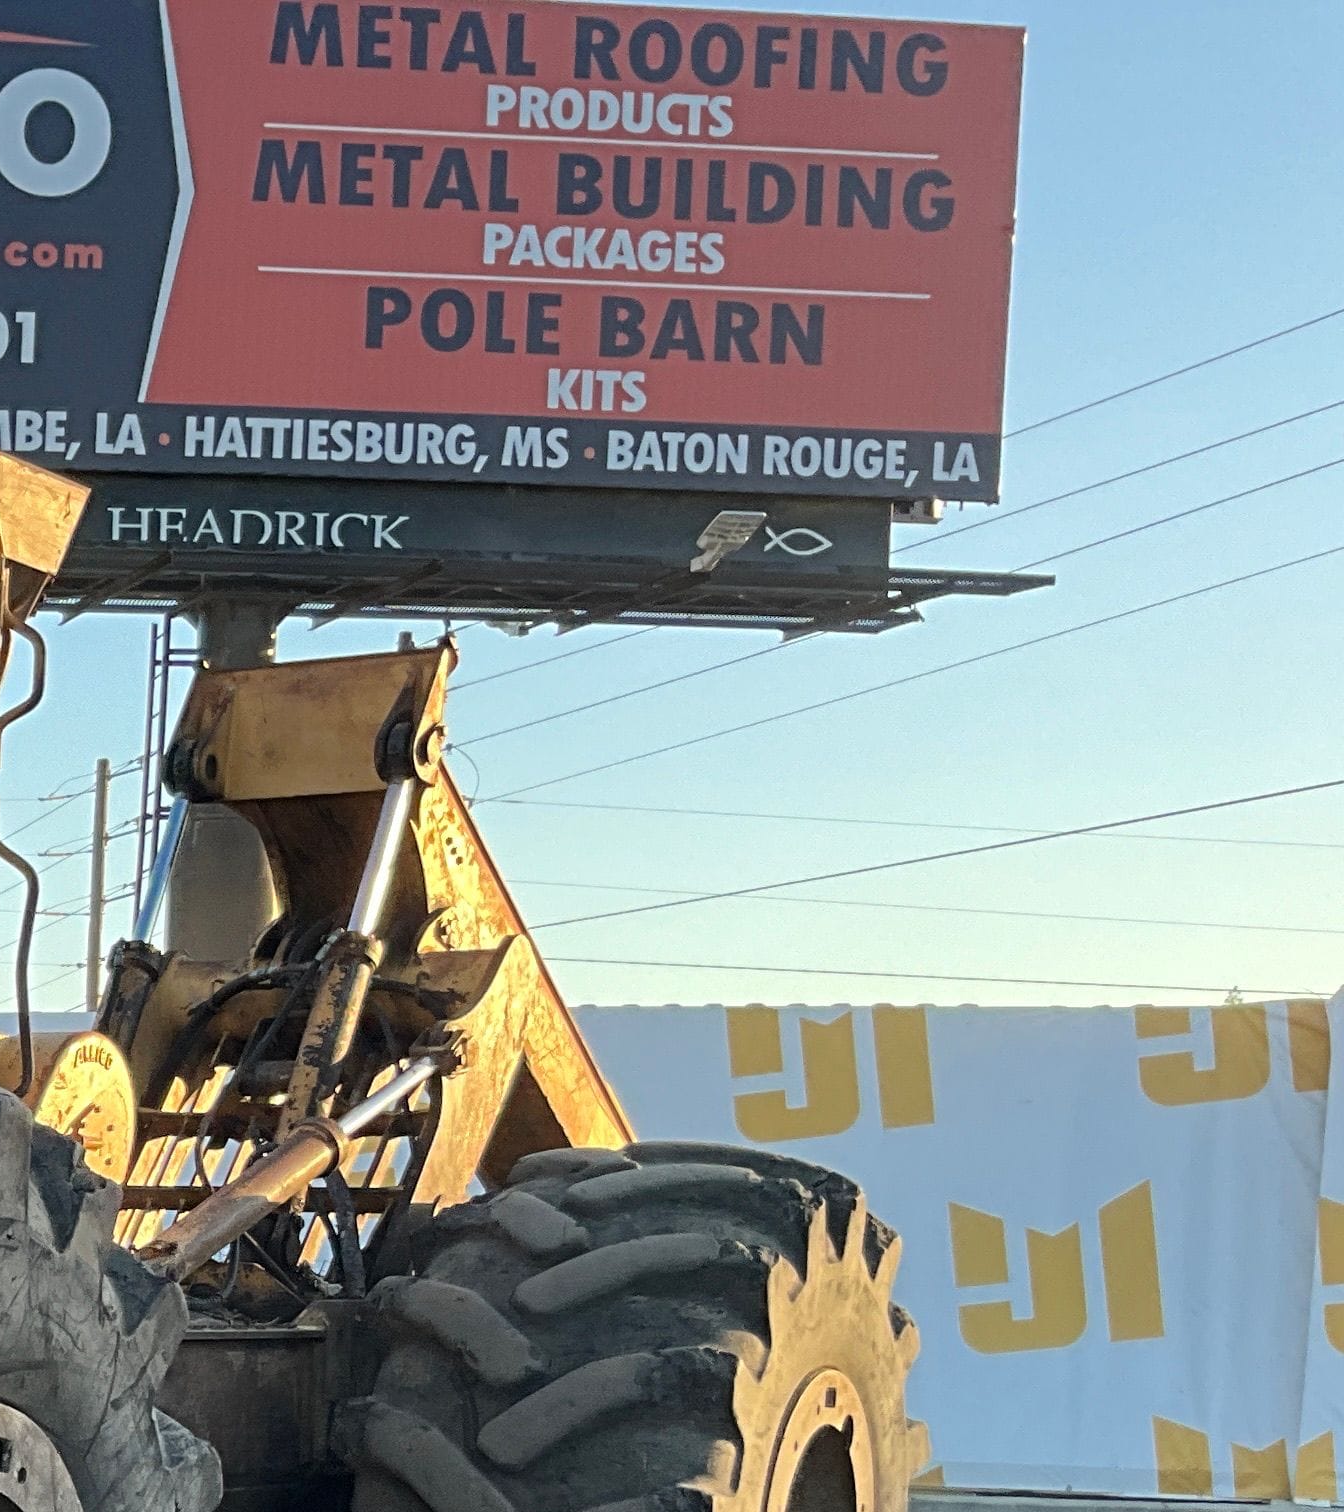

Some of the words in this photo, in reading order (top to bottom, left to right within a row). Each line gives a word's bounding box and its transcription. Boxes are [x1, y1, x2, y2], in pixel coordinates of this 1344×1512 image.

[269, 1, 536, 76] METAL
[573, 15, 950, 97] ROOFING
[486, 84, 734, 137] PRODUCTS
[252, 139, 520, 213] METAL
[556, 152, 955, 233] BUILDING
[483, 223, 726, 275] PACKAGES
[364, 286, 563, 356] POLE
[598, 296, 826, 366] BARN
[546, 367, 648, 413] KITS
[95, 413, 147, 455] LA
[184, 415, 489, 473] HATTIESBURG,
[501, 426, 570, 469] MS
[606, 430, 749, 476] BATON
[763, 435, 920, 488] ROUGE,
[932, 441, 982, 483] LA
[107, 506, 410, 550] HEADRICK
